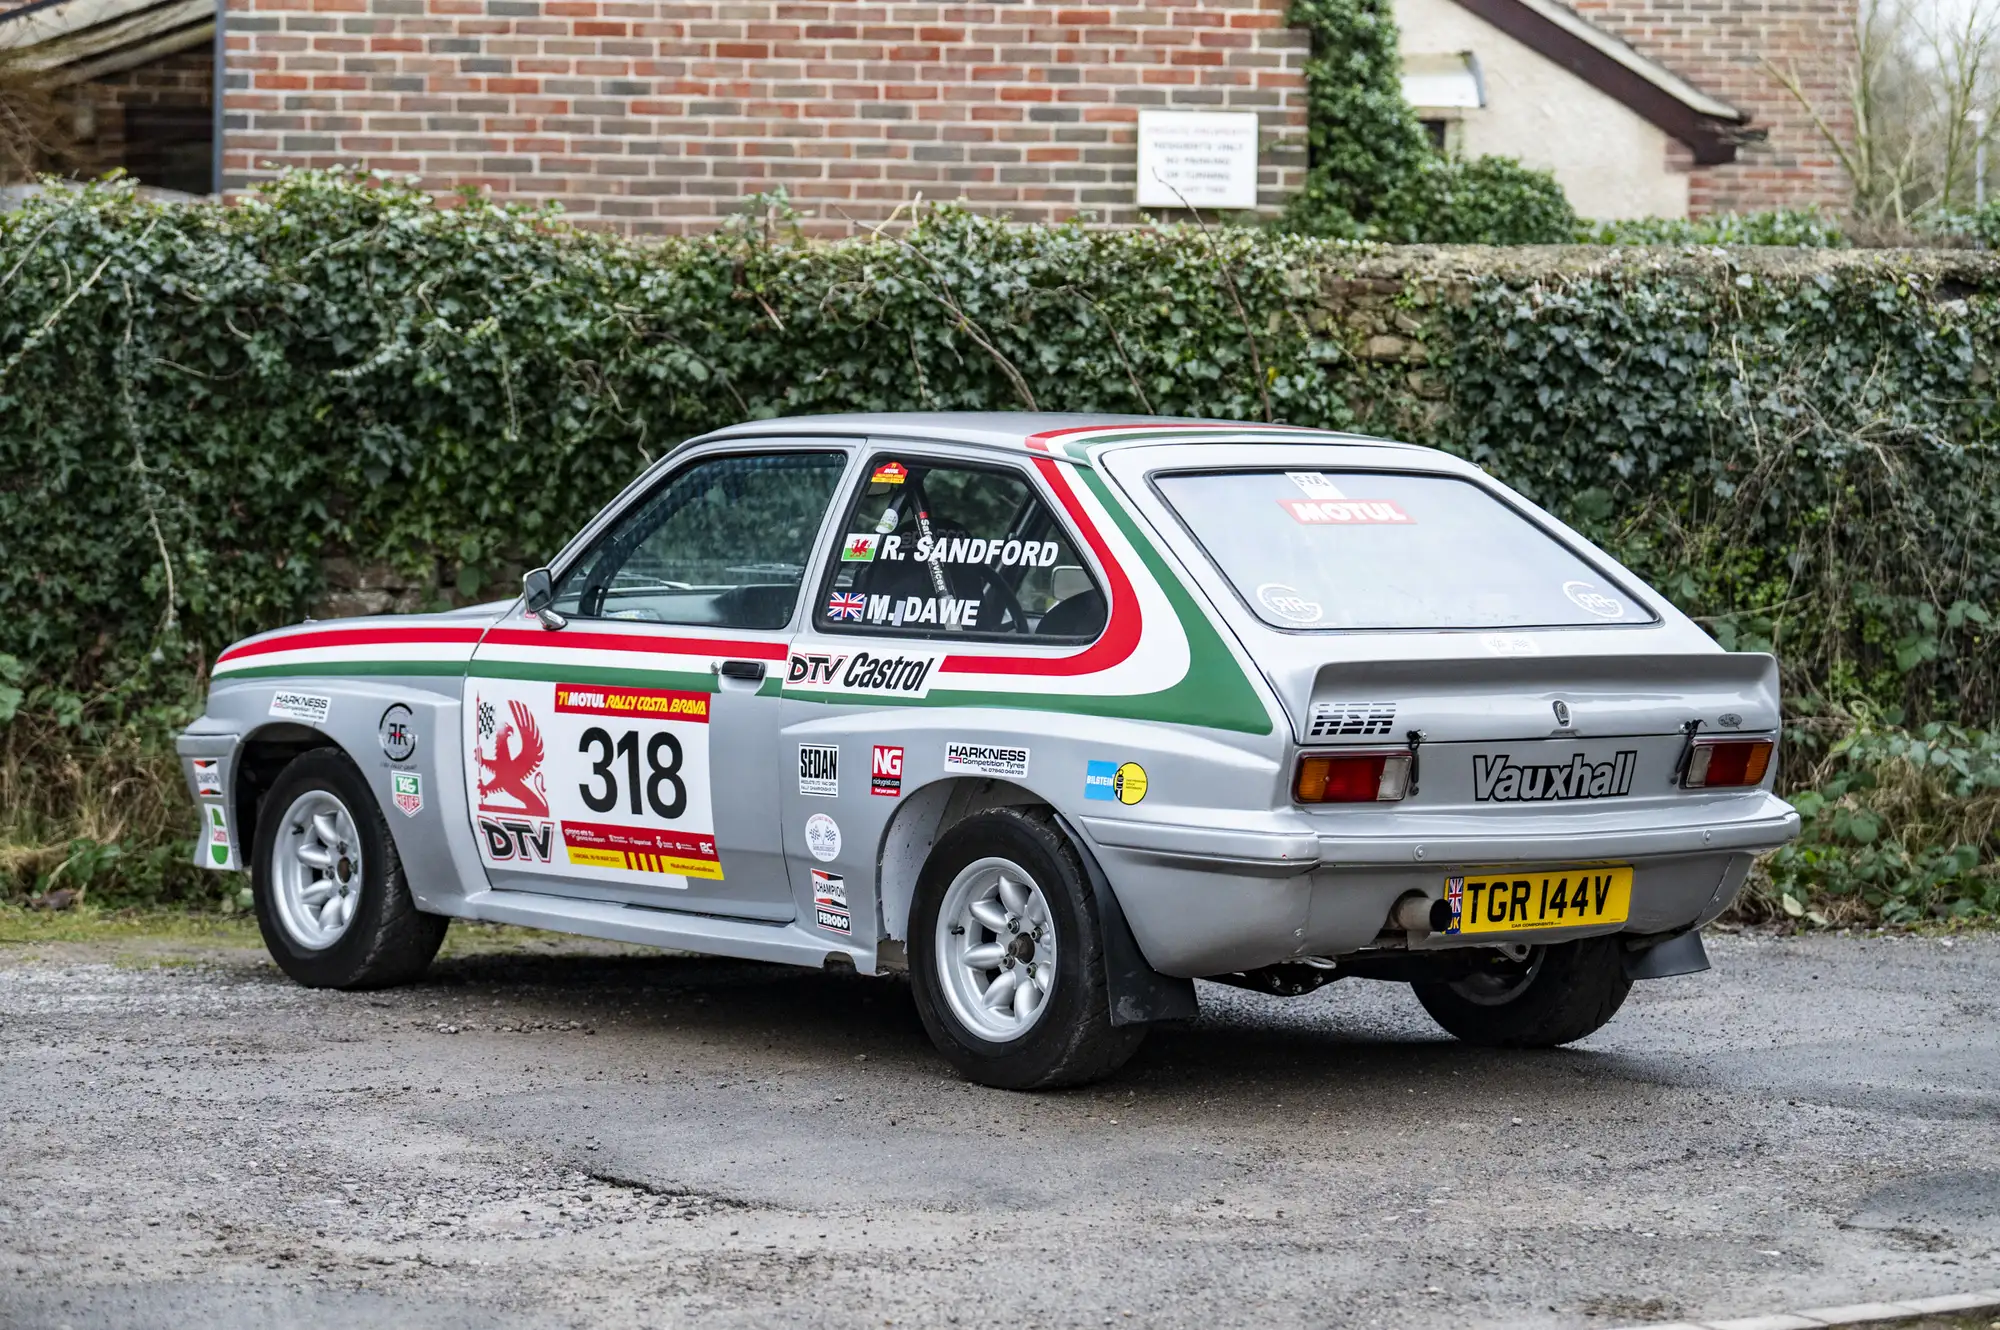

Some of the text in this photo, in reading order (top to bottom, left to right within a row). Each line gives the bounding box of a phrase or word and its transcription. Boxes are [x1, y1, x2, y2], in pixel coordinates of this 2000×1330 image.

[1291, 502, 1407, 520] MOTUL
[880, 535, 1058, 567] R. SANDFORD
[867, 594, 980, 626] M. DAWE
[786, 652, 935, 691] DTV Castrol
[276, 694, 328, 709] HARKNESS
[605, 694, 637, 710] RALLY
[637, 696, 668, 713] COSTA
[669, 698, 706, 715] BRAVA
[800, 748, 837, 780] SEDAN
[873, 748, 902, 776] NG
[949, 745, 1026, 762] HARKNESS
[962, 757, 1025, 769] Competition Tyres
[397, 777, 417, 793] TAG
[578, 726, 687, 820] 318
[1086, 775, 1115, 787] BILSTEIN
[1473, 750, 1638, 802] Vauxhall
[477, 815, 555, 863] DTV
[815, 881, 847, 897] CHAMPION
[1467, 875, 1612, 924] TGR 144V
[818, 911, 849, 929] FERODO
